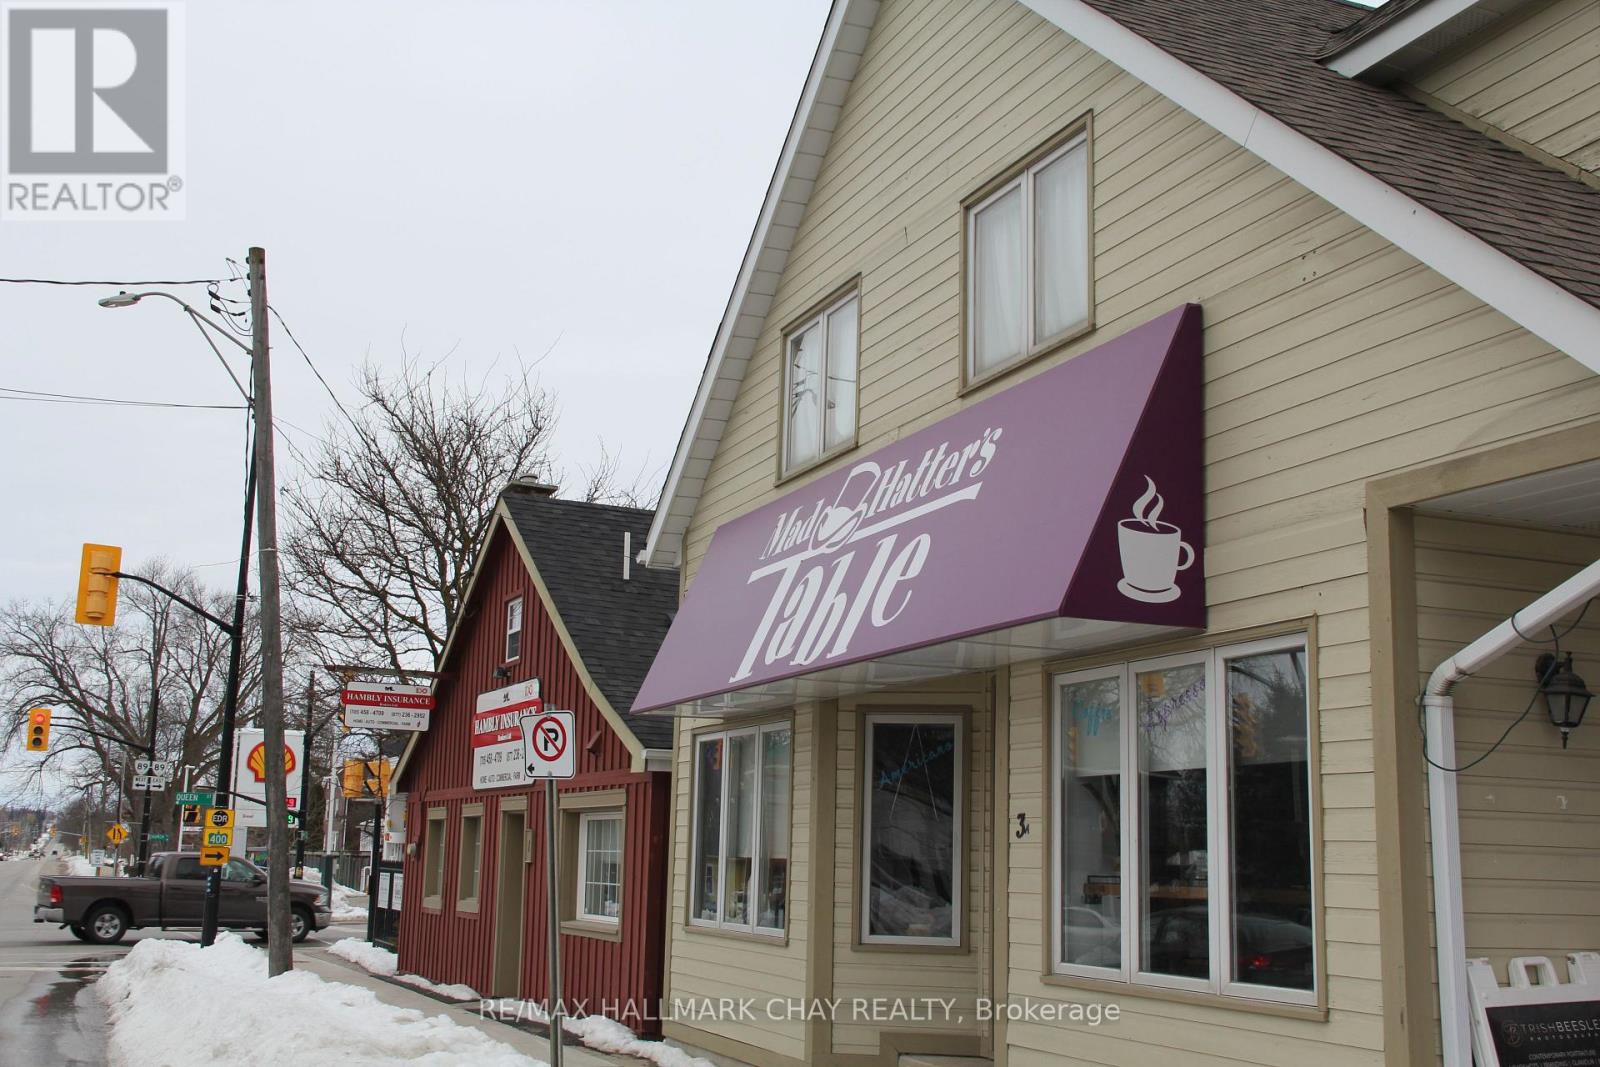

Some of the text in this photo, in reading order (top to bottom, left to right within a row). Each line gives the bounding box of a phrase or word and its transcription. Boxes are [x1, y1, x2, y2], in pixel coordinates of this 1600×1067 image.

[759, 427, 1002, 560] Mad Hatter's
[728, 533, 931, 683] Table
[347, 693, 382, 702] HAMBLY
[384, 695, 431, 705] INSURANCE
[474, 716, 499, 735] HAMBLY
[210, 834, 227, 844] 400
[1520, 1019, 1600, 1034] TRISHBEESLE
